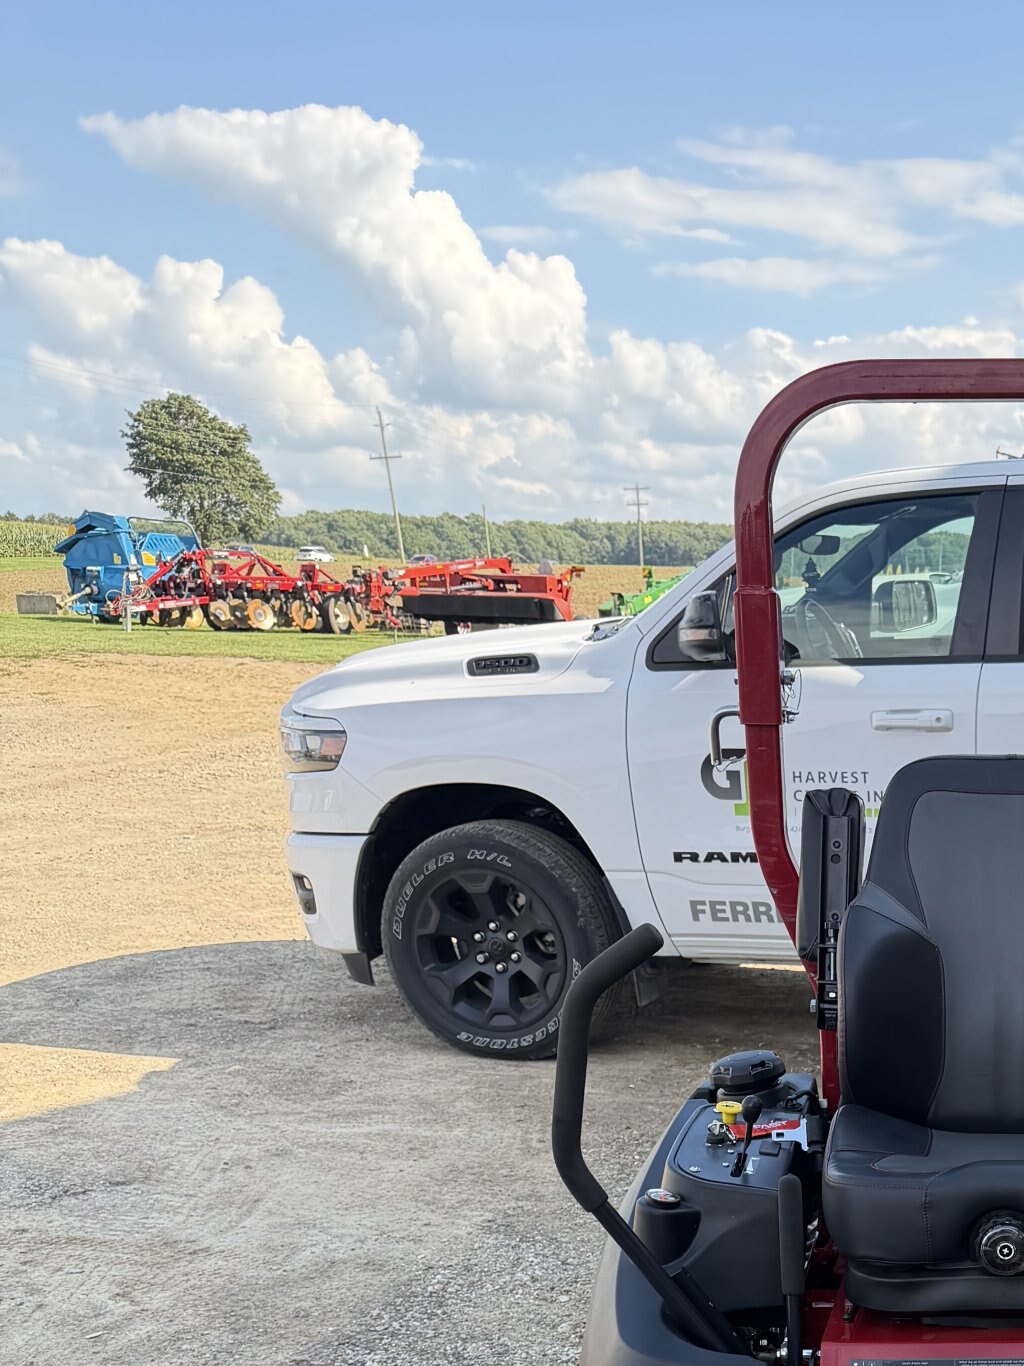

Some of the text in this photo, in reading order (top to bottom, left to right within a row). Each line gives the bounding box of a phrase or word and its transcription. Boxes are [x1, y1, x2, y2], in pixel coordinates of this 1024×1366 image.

[792, 771, 869, 783] HARVEST
[673, 851, 759, 863] RAM
[393, 849, 511, 939] DUELER H/L
